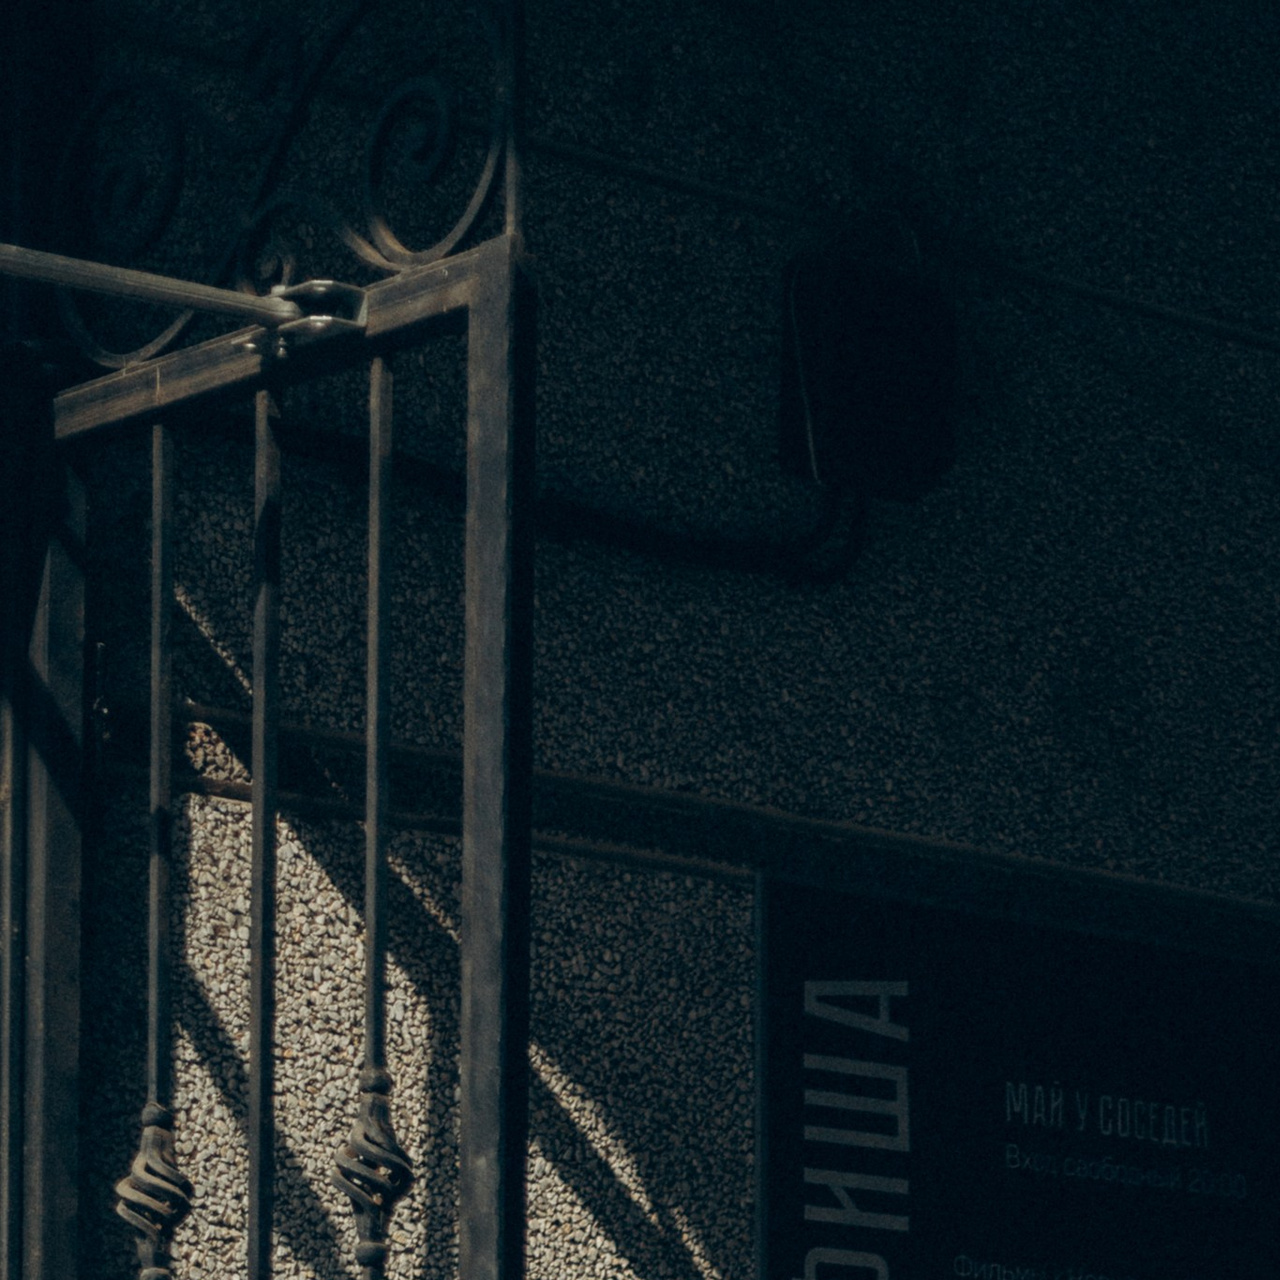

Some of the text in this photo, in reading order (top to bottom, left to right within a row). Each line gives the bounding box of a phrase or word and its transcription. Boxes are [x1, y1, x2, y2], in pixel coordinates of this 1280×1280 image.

[1005, 1079, 1210, 1150] МАЙ У СОСЕДЕЙ
[1005, 1143, 1058, 1178] Вход
